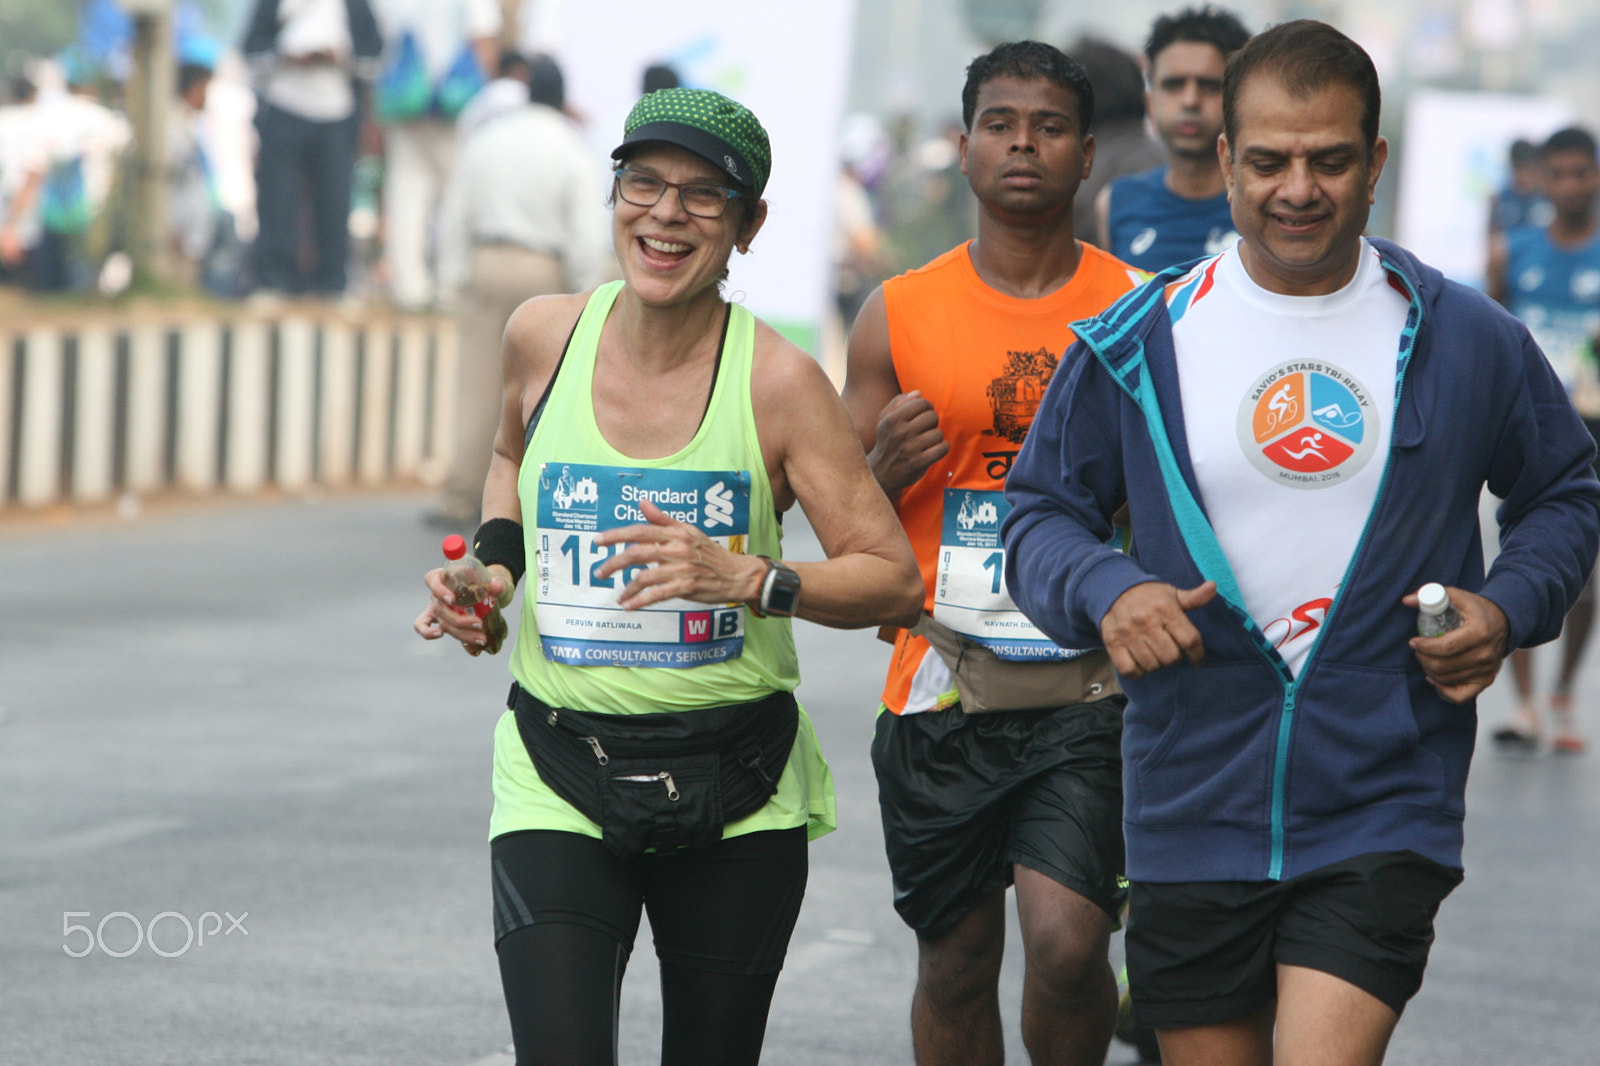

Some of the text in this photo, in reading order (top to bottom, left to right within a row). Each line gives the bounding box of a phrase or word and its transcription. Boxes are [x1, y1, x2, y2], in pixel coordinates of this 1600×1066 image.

[1252, 363, 1369, 407] SAVIO'S STARS TRI-RELAY
[1322, 471, 1341, 481] 2016
[621, 485, 697, 504] Standard
[566, 618, 642, 630] PERVIN BATLIWALA
[688, 611, 738, 636] W B
[984, 620, 1019, 628] NAVNATH
[551, 645, 727, 663] TATA CONSULTANCY SERVICES
